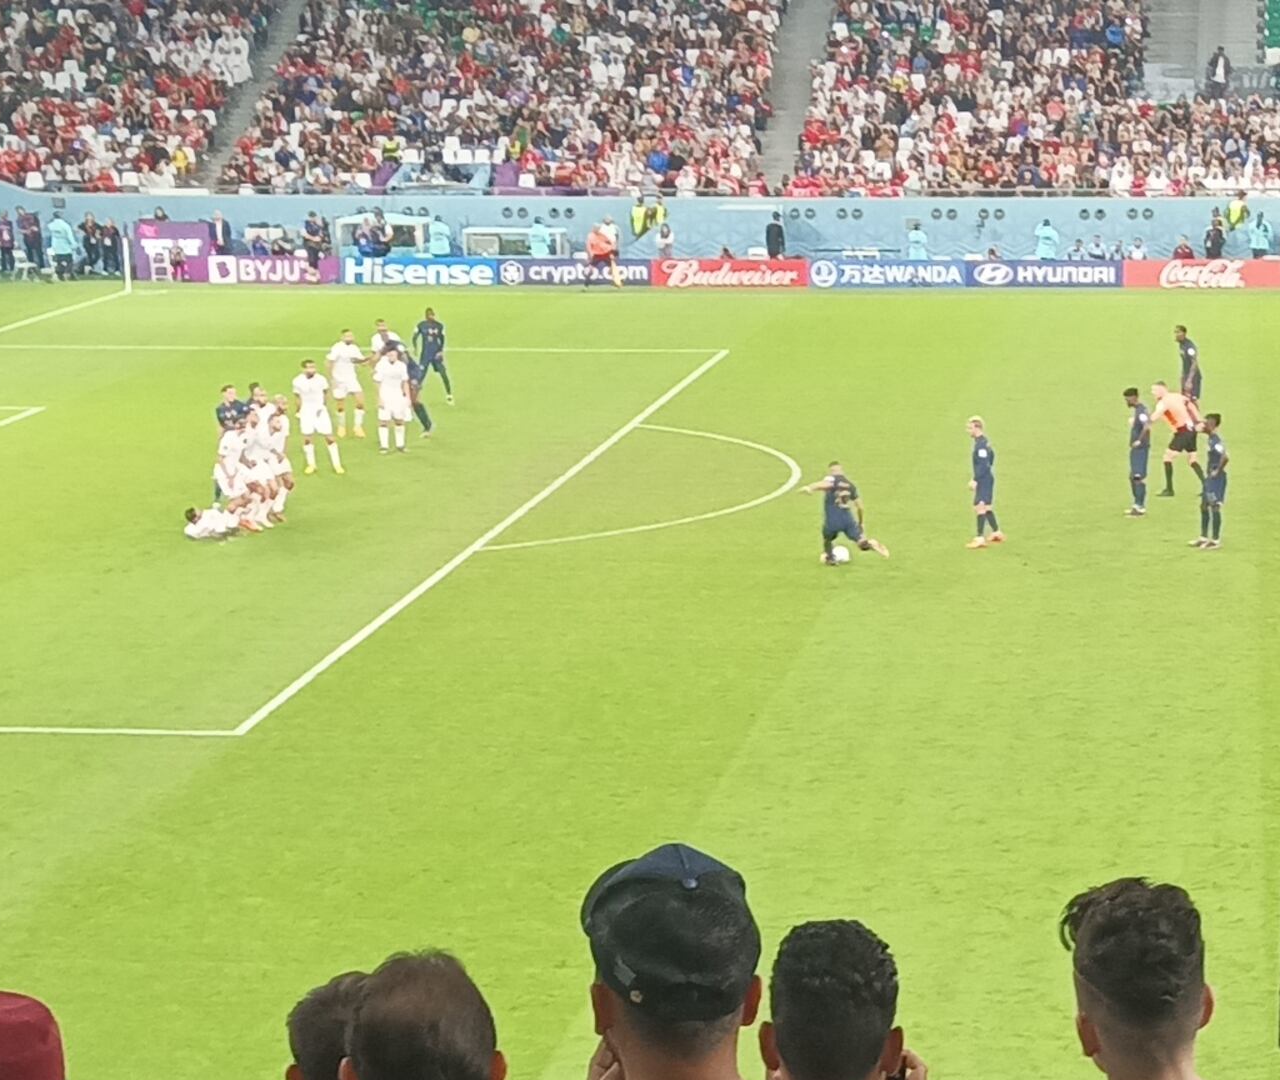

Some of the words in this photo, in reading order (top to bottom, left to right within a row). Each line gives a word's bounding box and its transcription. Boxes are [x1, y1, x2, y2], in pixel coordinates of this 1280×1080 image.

[344, 257, 493, 285] Hisense
[661, 259, 799, 287] Budweiser
[1016, 266, 1116, 283] HYUNDAI
